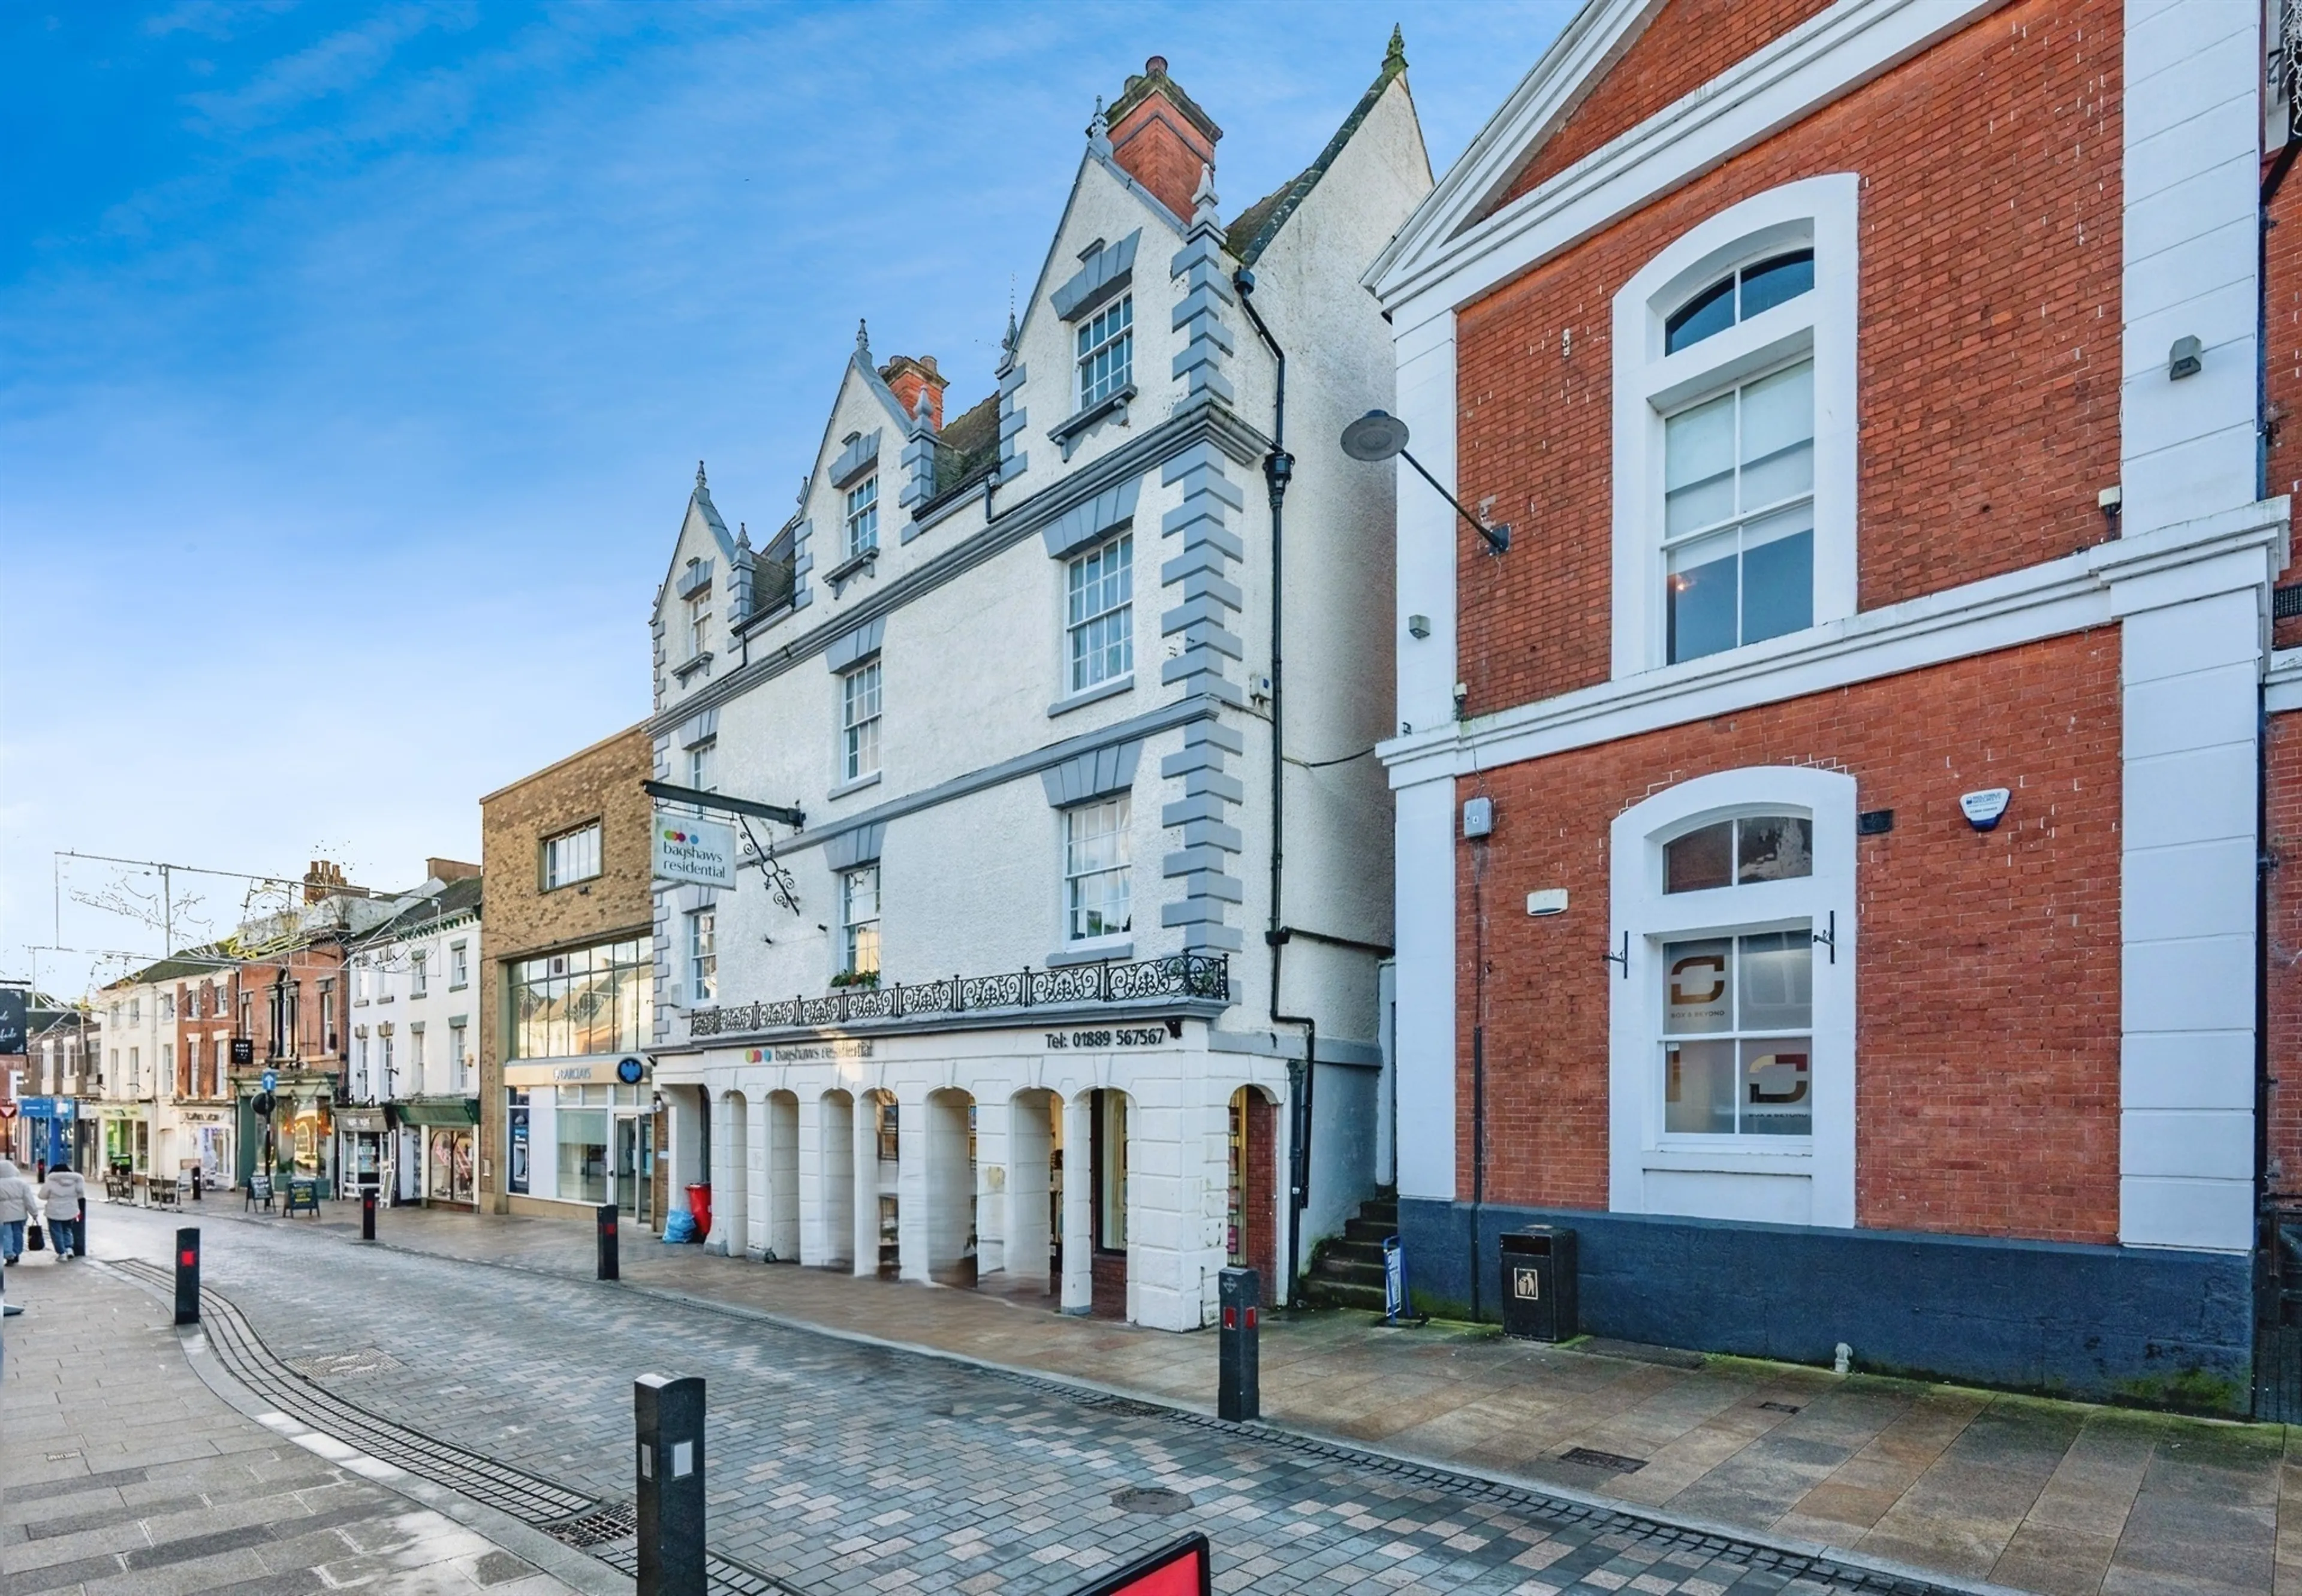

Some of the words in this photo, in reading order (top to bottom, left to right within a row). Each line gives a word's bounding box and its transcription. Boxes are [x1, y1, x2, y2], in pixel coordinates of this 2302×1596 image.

[663, 841, 723, 863] bagshaws
[664, 860, 725, 879] residential
[1045, 1032, 1067, 1049] Tel:
[1072, 1031, 1111, 1048] 01889
[1116, 1028, 1165, 1045] 567567
[775, 1045, 819, 1065] bagshaws
[821, 1040, 873, 1059] residential
[561, 1067, 591, 1079] BARCLAYS
